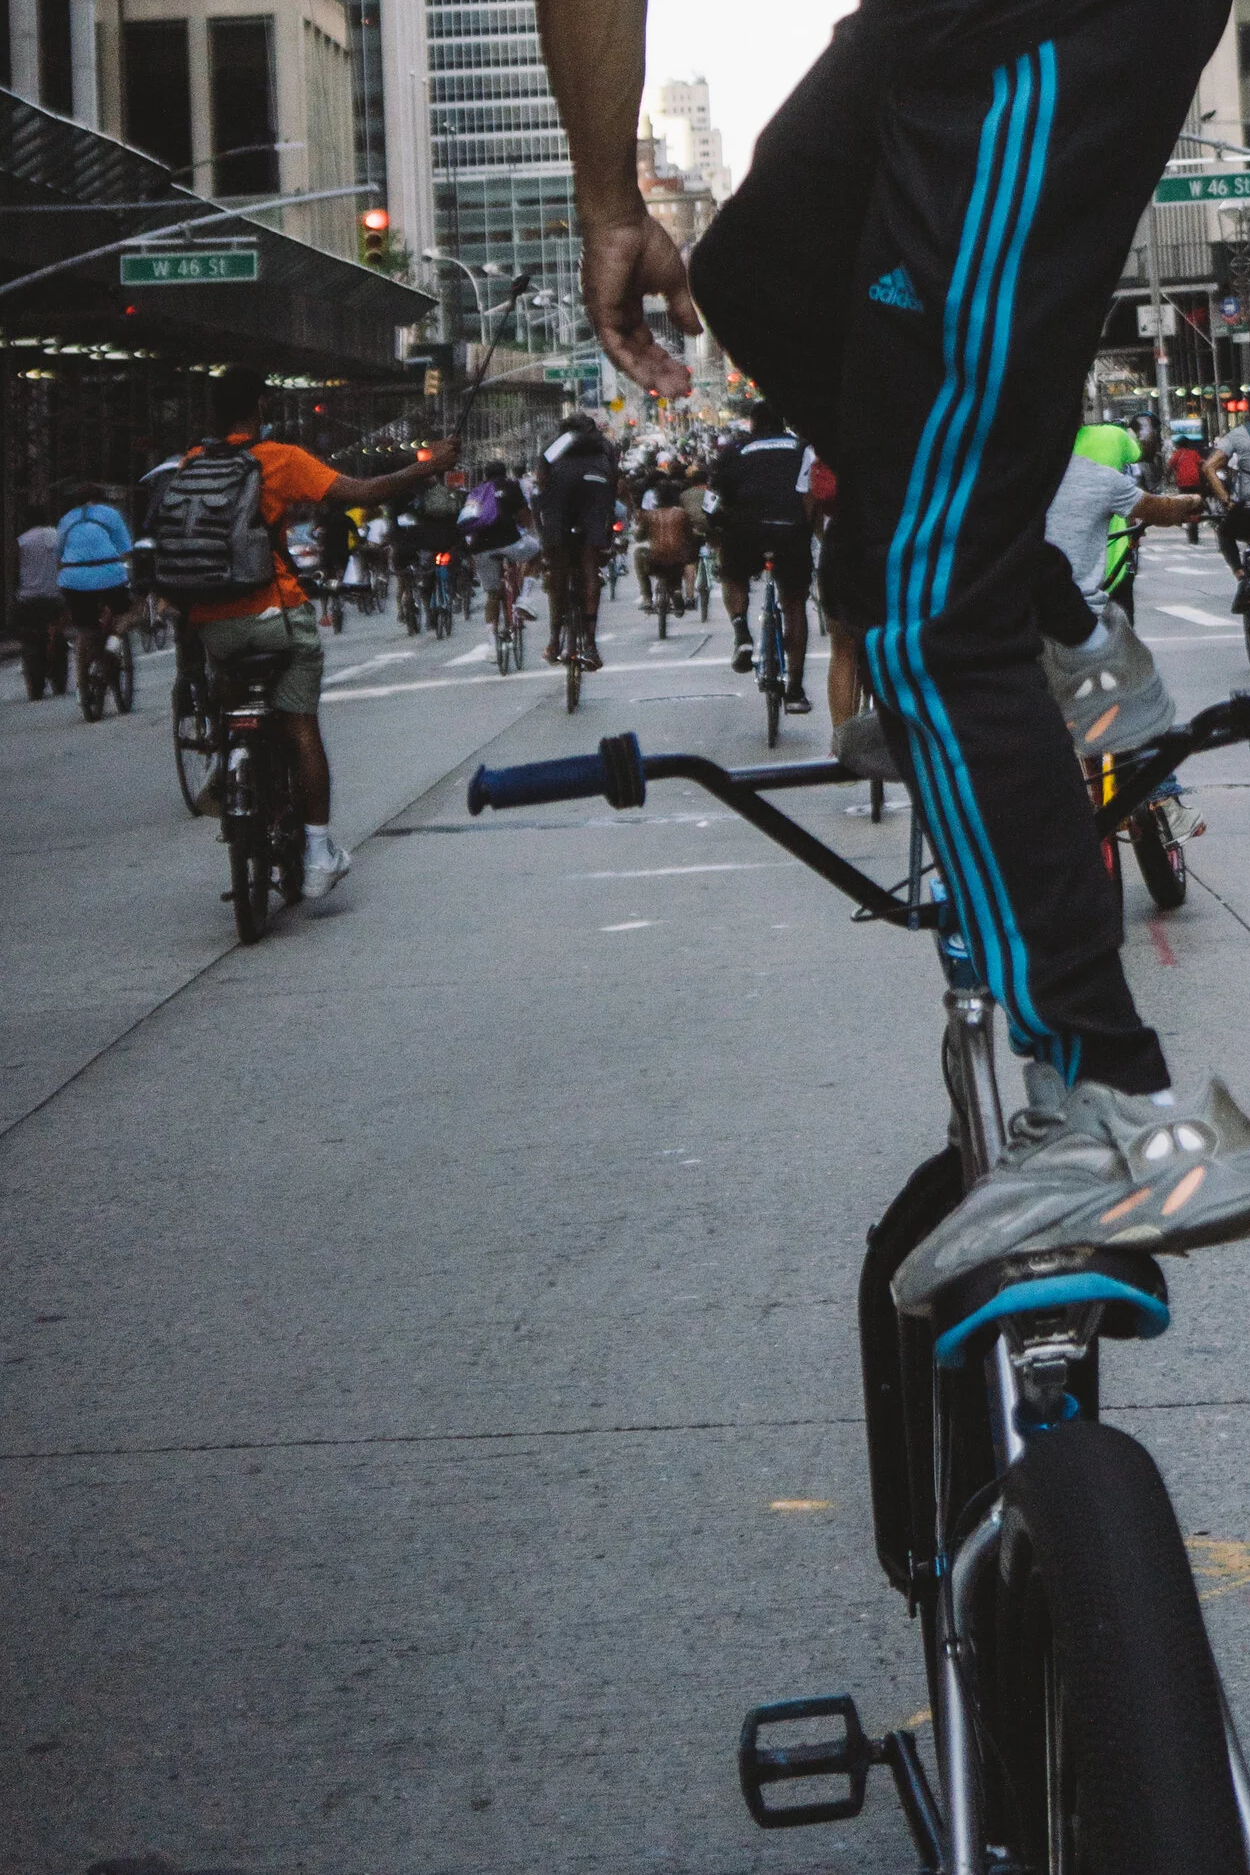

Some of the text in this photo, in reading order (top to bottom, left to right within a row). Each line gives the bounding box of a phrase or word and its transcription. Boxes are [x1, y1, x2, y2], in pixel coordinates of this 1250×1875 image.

[1188, 179, 1203, 198] W
[1207, 178, 1228, 196] 46
[152, 257, 225, 277] W 46 St
